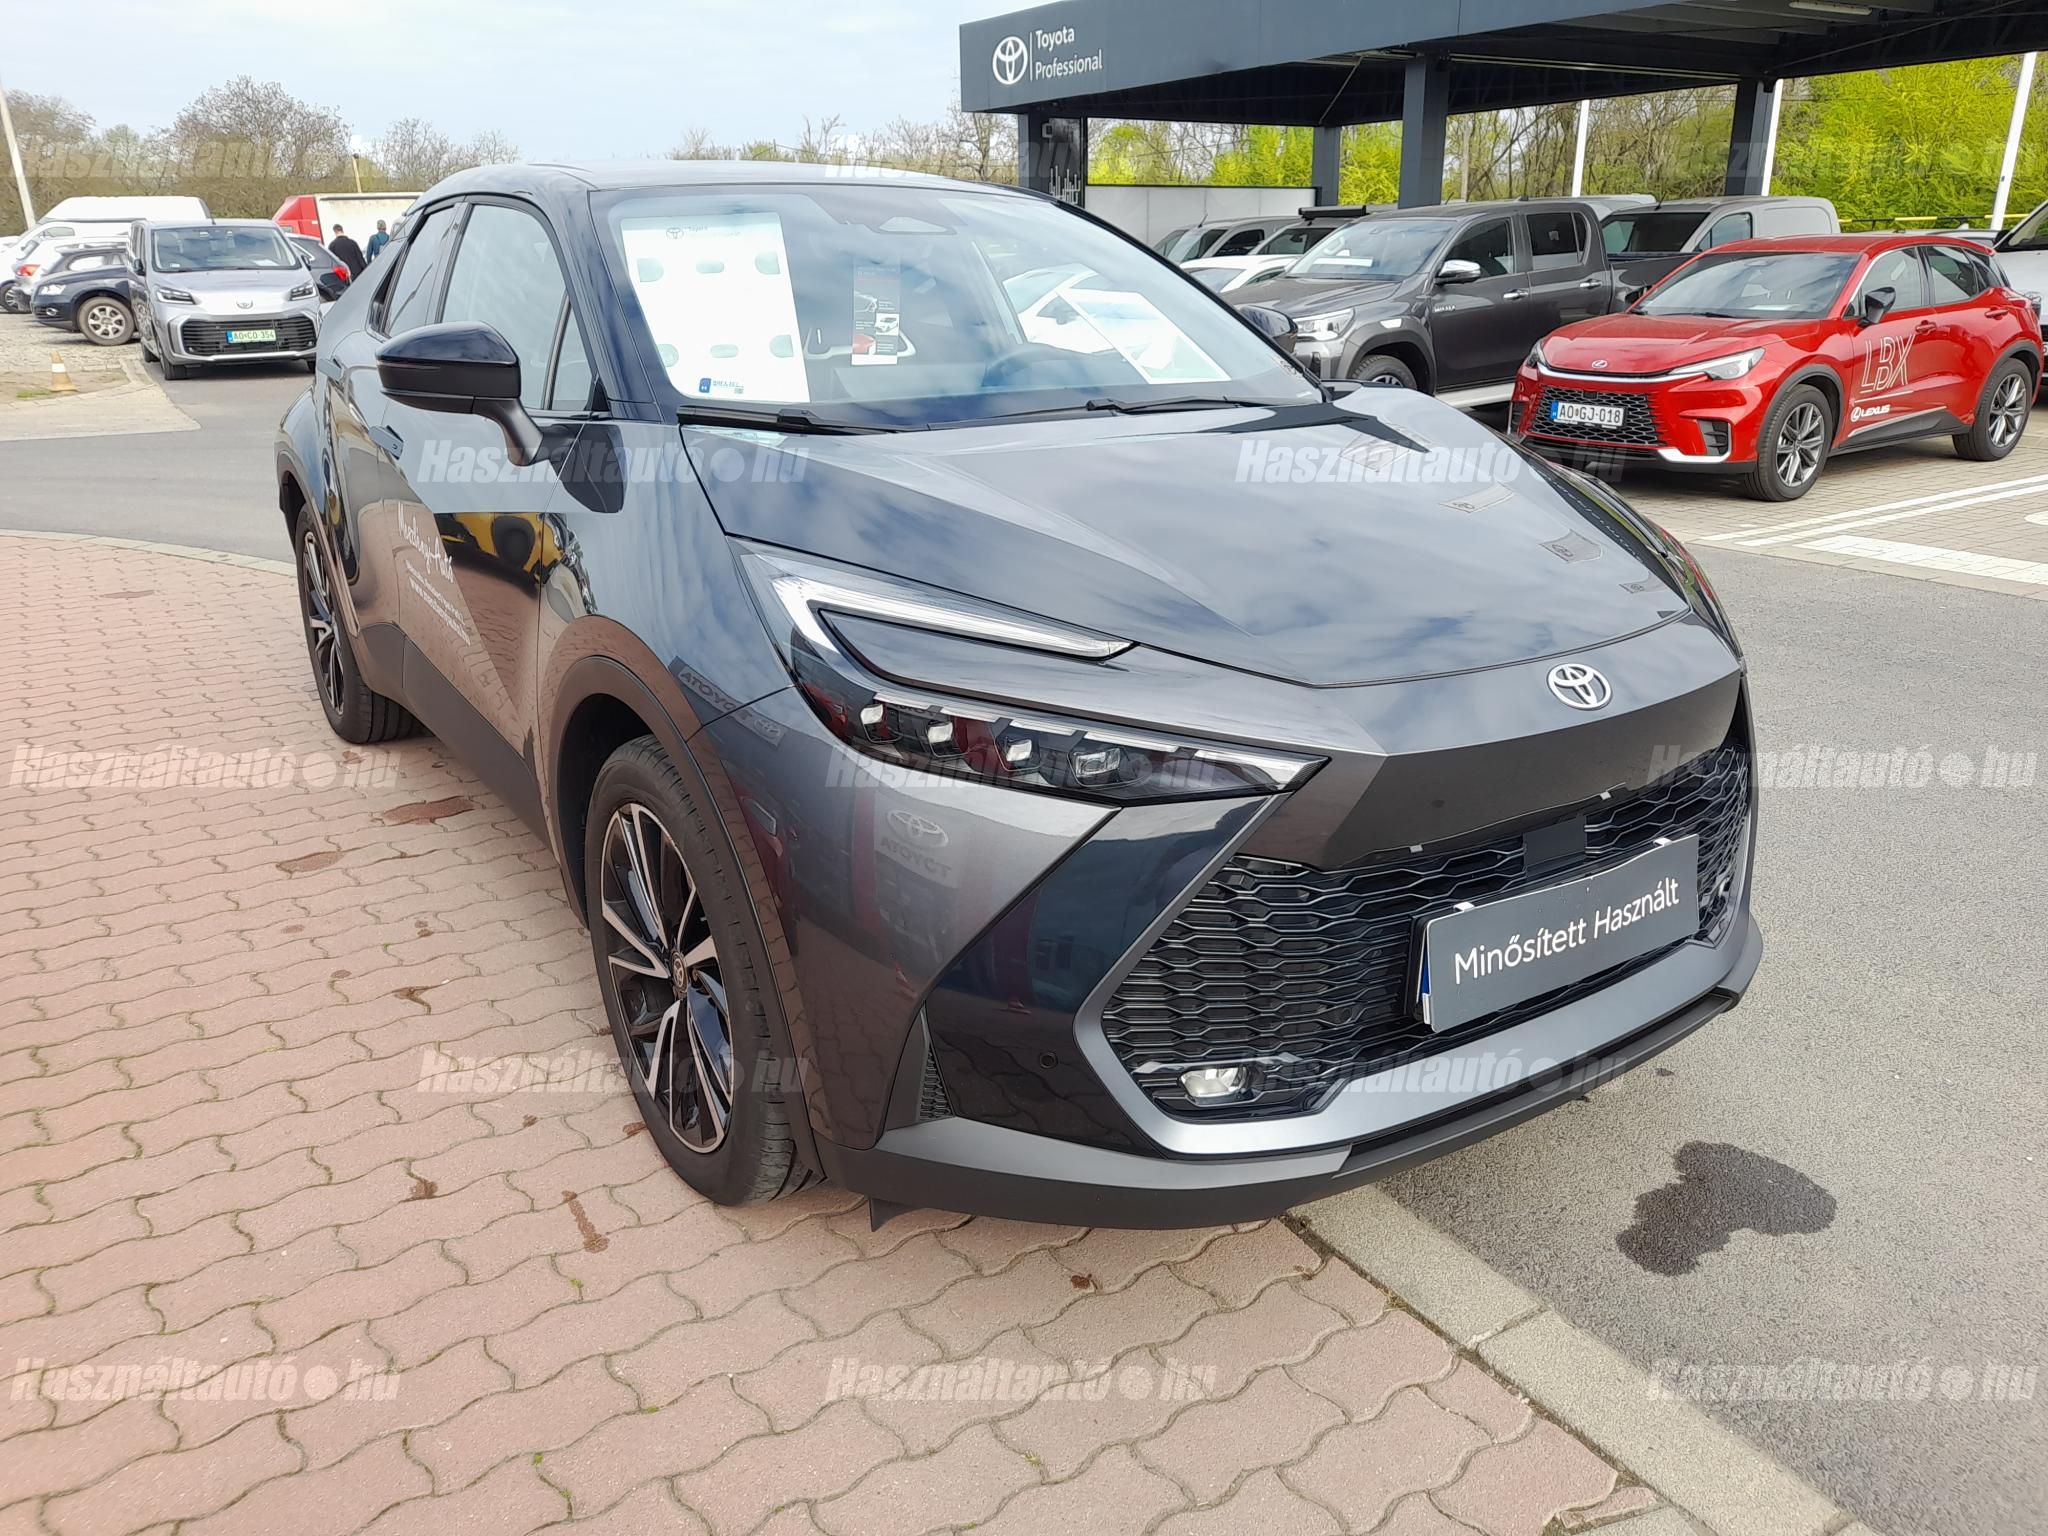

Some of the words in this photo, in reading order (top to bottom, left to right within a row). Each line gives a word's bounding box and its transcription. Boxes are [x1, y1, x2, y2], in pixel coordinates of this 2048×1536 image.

[1035, 26, 1075, 52] Toyota
[1035, 49, 1103, 80] Professional
[1860, 334, 1916, 394] LBX
[1860, 404, 1891, 418] LEXUS
[1453, 918, 1588, 985] Minősített
[1593, 876, 1680, 940] Használt
